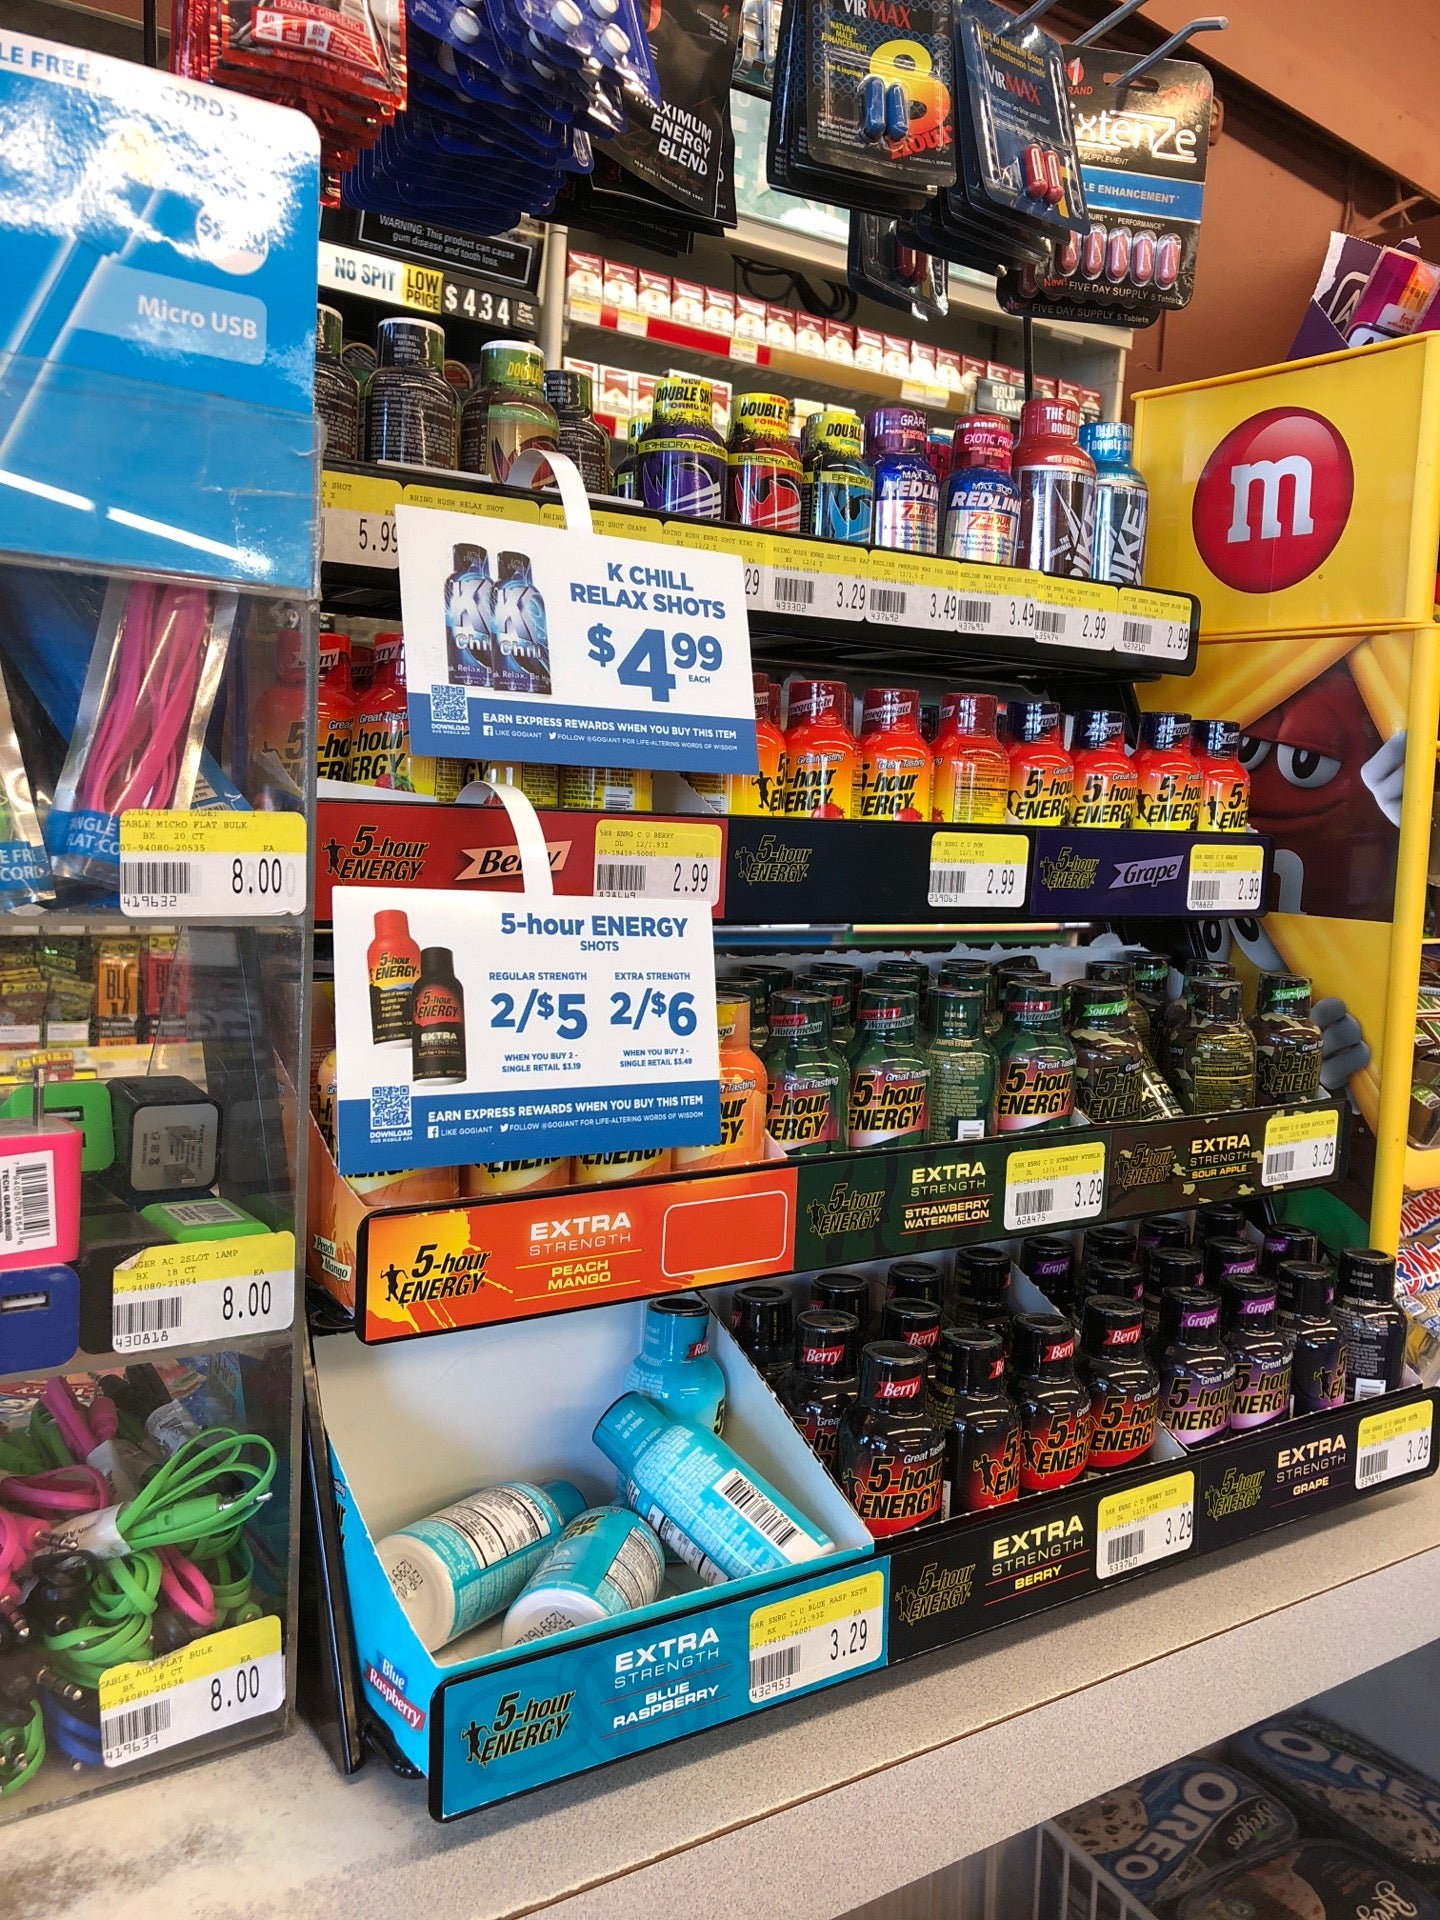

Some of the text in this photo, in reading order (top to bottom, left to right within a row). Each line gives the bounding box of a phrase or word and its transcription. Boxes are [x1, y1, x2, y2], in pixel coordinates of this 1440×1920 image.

[830, 21, 858, 36] NATURAL
[836, 30, 853, 41] MALE
[821, 35, 867, 52] ENHANCEMENT
[31, 51, 91, 82] FREE
[650, 115, 710, 160] ENERGY
[658, 137, 708, 176] BLEND
[379, 214, 515, 260] WARNING: This product can cause
[392, 232, 411, 244] gum
[412, 235, 443, 252] disease
[444, 246, 460, 257] and
[460, 248, 481, 262] tooth
[334, 256, 396, 292] NO SPIT
[407, 268, 439, 293] LOW
[406, 289, 440, 311] PRICE
[1068, 280, 1149, 300] FIVE DAY SUPPLY
[137, 295, 258, 340] Micro USB
[655, 385, 697, 404] DOUBLE
[900, 414, 927, 428] GRAPE
[963, 432, 995, 446] EXOTIC
[737, 453, 786, 467] EPHEDRA
[409, 493, 505, 514] RHINO RUSH RELAX SHOT
[1227, 454, 1314, 544] m
[606, 562, 695, 592] K CHILL
[569, 582, 727, 620] RELAX SHOTS
[775, 602, 807, 614] 433302
[836, 581, 866, 611] 3.29
[929, 594, 957, 620] 3.49
[1009, 602, 1035, 627] 3.49
[1082, 613, 1107, 640] 2.99
[1166, 625, 1189, 649] 2.99
[687, 673, 711, 685] EACH
[119, 820, 248, 830] CABLE MICRO FLAT BULK
[352, 825, 429, 860] 5-hour
[231, 857, 283, 895] 8.00
[338, 857, 425, 883] ENERGY
[672, 862, 709, 893] 2.99
[986, 868, 1015, 895] 2.99
[1123, 860, 1178, 887] Grape
[122, 895, 178, 908] 419632
[1238, 877, 1260, 901] 2.99
[501, 912, 688, 939] 5-hour ENERGY
[580, 940, 620, 953] SHOTS
[488, 971, 588, 982] REGULAR STRENGTH
[614, 971, 691, 981] EXTRA STRENGTH
[501, 1062, 582, 1074] SINGLE RETAIL $3.19
[504, 1051, 574, 1063] WHEN YOU BUY 2
[619, 1057, 693, 1068] SINGLE RETAIL $3.49
[427, 1094, 704, 1123] EARN EXPRESS REWARDS WHEN YOU BUY THIS ITEM
[369, 1130, 413, 1140] DOWNLOAD
[440, 1127, 458, 1137] LIKE
[458, 1125, 493, 1136] GOGIANT
[509, 1122, 540, 1132] FOLLOW
[579, 1118, 594, 1127] FOR
[595, 1115, 642, 1126] LIFE-ALTERING
[643, 1113, 667, 1122] WORDS
[667, 1112, 677, 1121] OF
[677, 1110, 704, 1120] WISDOM
[1190, 1133, 1251, 1154] EXTRA
[1311, 1141, 1335, 1168] 3.29
[1189, 1150, 1251, 1167] STRENGTH
[911, 1161, 987, 1184] EXTRA
[1191, 1164, 1248, 1180] SOUR APPLE
[910, 1179, 986, 1198] STRENGTH
[1074, 1177, 1103, 1209] 3.29
[903, 1208, 990, 1230] WATERMELON
[904, 1199, 990, 1219] STRAWBERRY
[529, 1211, 633, 1242] EXTRA
[528, 1231, 633, 1257] STRENGTH
[161, 1249, 239, 1266] AC 2SLOT 1AMP
[411, 1243, 493, 1281] 5-hour
[550, 1258, 611, 1279] PEACH
[398, 1272, 487, 1306] ENERGY
[546, 1269, 612, 1292] MANGO
[222, 1280, 272, 1321] 8.00
[1186, 1311, 1218, 1330] Grape
[115, 1330, 170, 1349] 430818
[805, 1348, 843, 1365] Berry
[883, 1379, 919, 1399] Berry
[1277, 1432, 1348, 1469] EXTRA
[1406, 1433, 1430, 1464] 3.29
[1276, 1451, 1348, 1484] STRENGTH
[1292, 1475, 1330, 1496] GRAPE
[992, 1514, 1085, 1561] EXTRA
[1165, 1510, 1194, 1546] 3.29
[991, 1535, 1085, 1578] STRENGTH
[1013, 1563, 1063, 1590] BERRY
[808, 1600, 827, 1613] BLUE
[829, 1593, 848, 1607] RASP
[614, 1626, 721, 1674] EXTRA
[829, 1618, 869, 1661] 3.29
[100, 1645, 214, 1690] CABLE AUX FLAT BULK
[380, 1656, 406, 1691] Blue
[612, 1645, 721, 1690] STRENGTH
[210, 1665, 260, 1712] 8.00
[367, 1667, 424, 1728] Raspberry
[643, 1681, 691, 1706] BLUE
[751, 1676, 792, 1700] 432953
[491, 1690, 577, 1732] 5-hour
[612, 1684, 720, 1730] RASPBERRY
[105, 1733, 160, 1762] 419639
[478, 1713, 571, 1768] ENERGY
[1114, 1771, 1240, 1881] OREO
